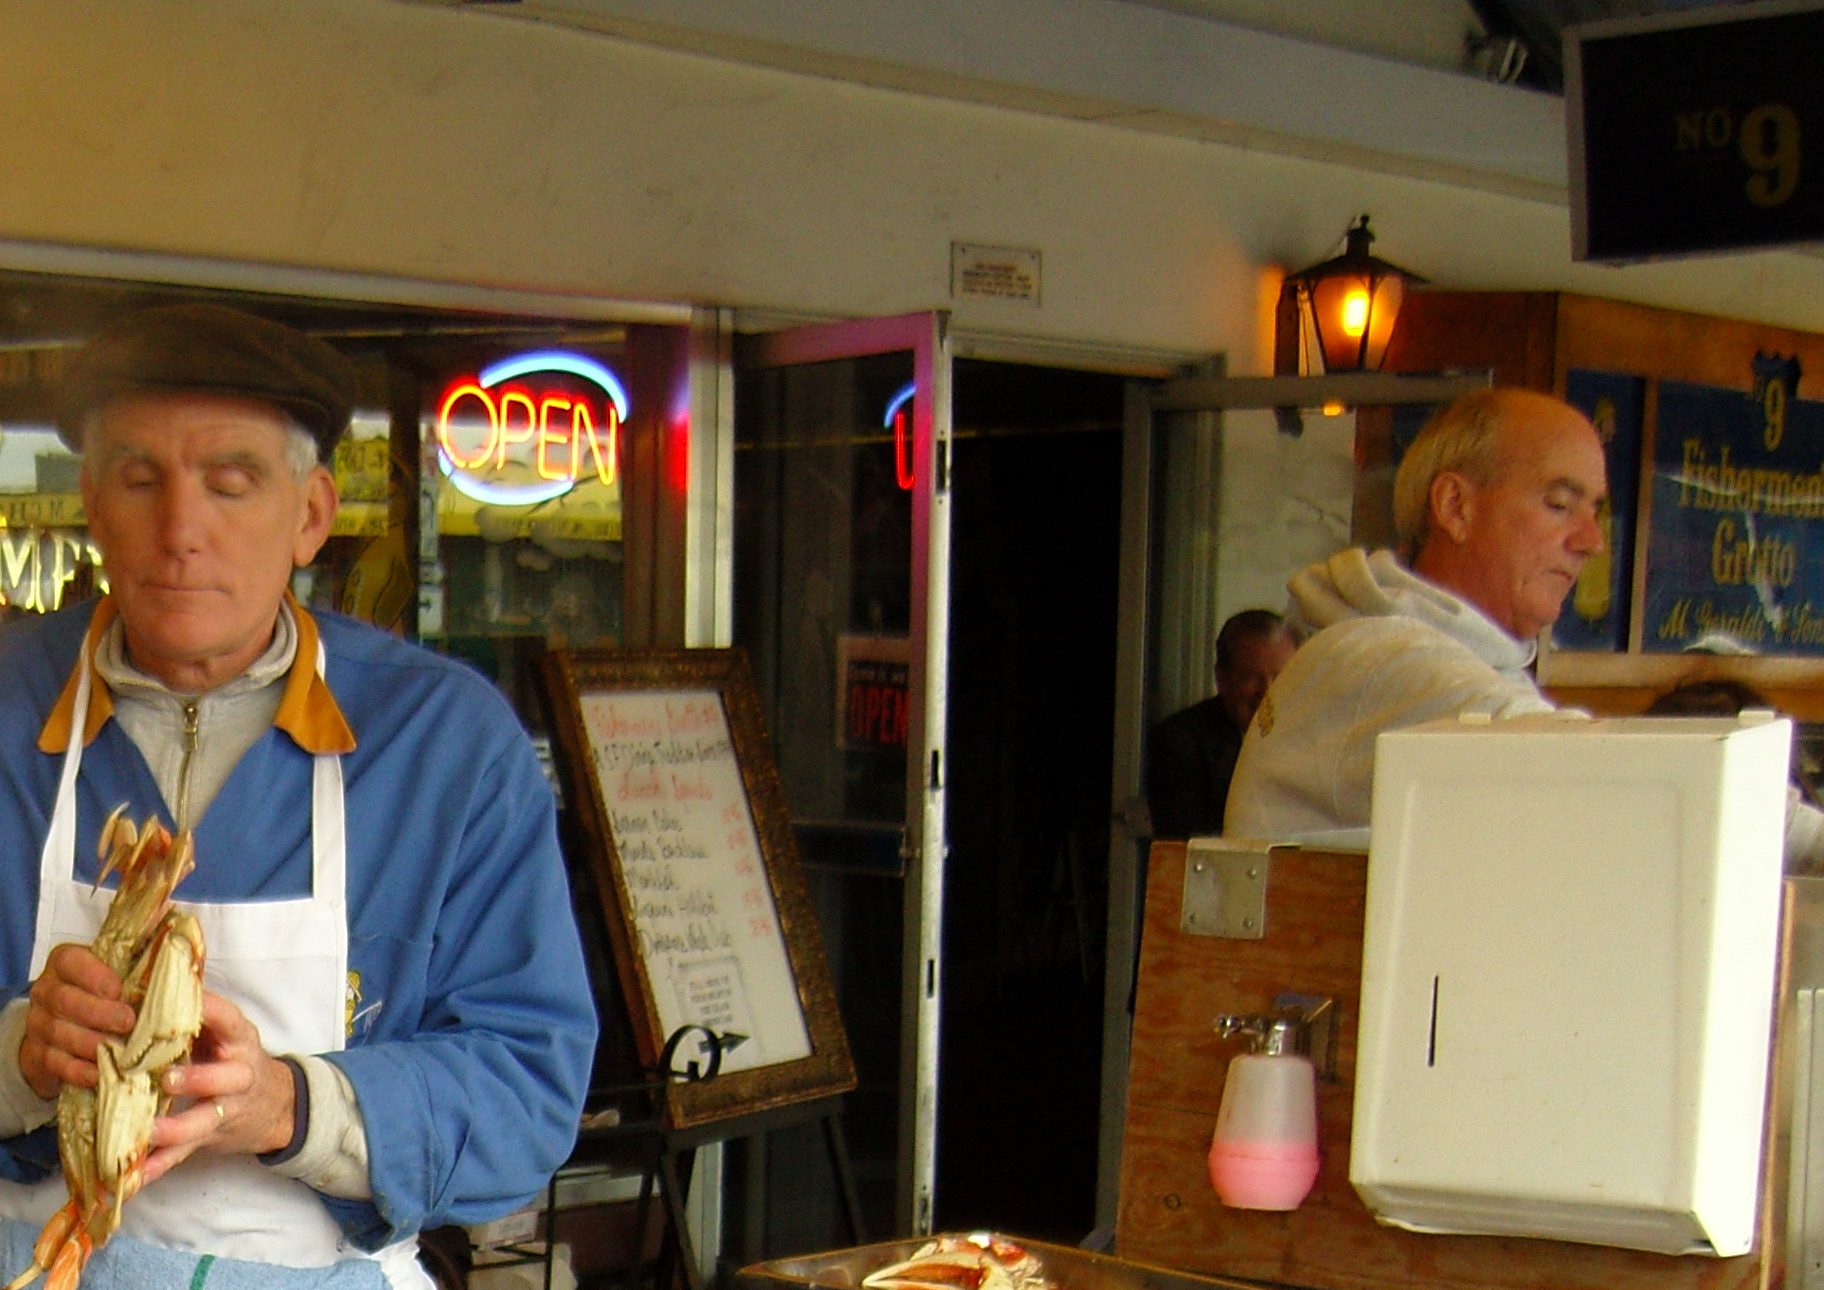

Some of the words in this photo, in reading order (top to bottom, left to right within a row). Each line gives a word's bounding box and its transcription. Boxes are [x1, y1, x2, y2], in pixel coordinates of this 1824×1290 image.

[1739, 103, 1801, 208] 9
[438, 383, 619, 487] OPEN
[1763, 377, 1786, 452] 9
[1712, 517, 1796, 587] Grotto
